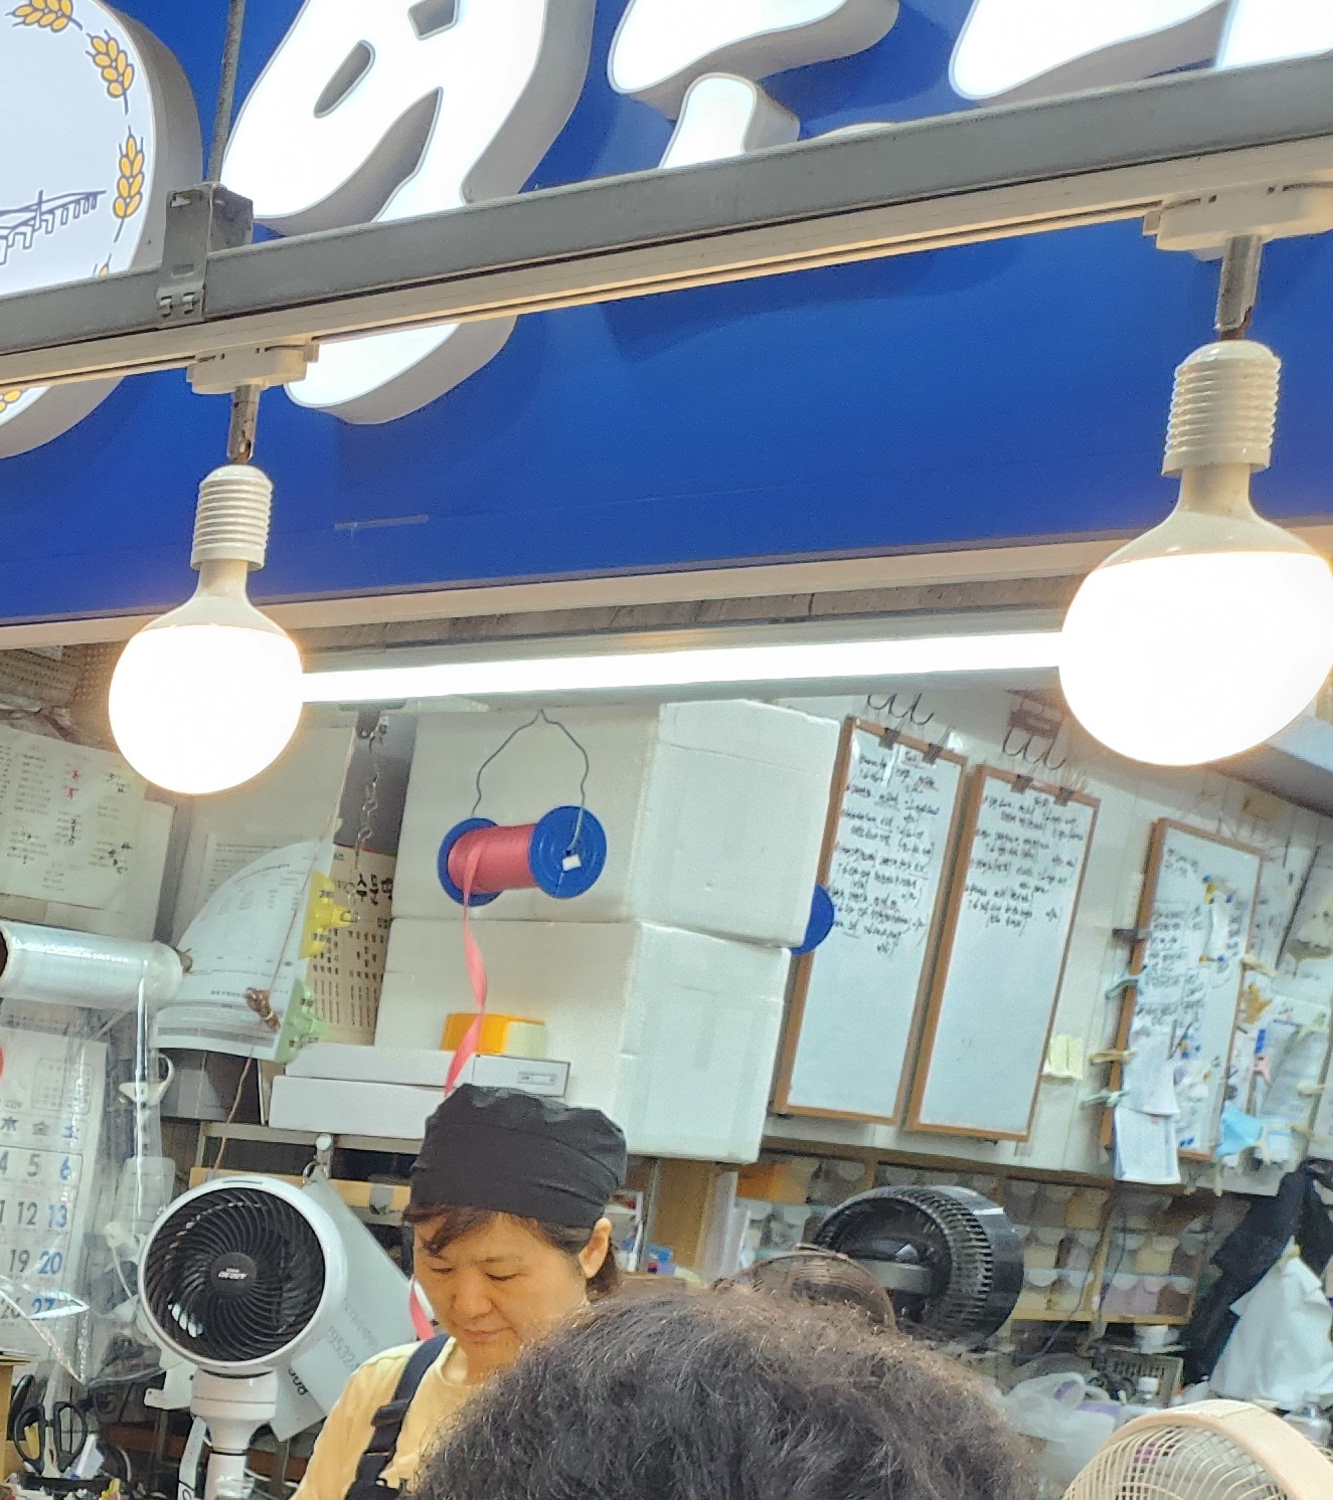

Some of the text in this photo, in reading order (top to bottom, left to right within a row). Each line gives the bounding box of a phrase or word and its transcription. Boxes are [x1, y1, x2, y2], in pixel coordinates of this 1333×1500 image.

[0, 1115, 19, 1132] 木
[27, 1154, 40, 1177] 5
[59, 1156, 71, 1180] 6
[17, 1201, 38, 1226] 12
[48, 1204, 68, 1228] 13
[8, 1249, 30, 1273] 19
[37, 1250, 63, 1276] 20
